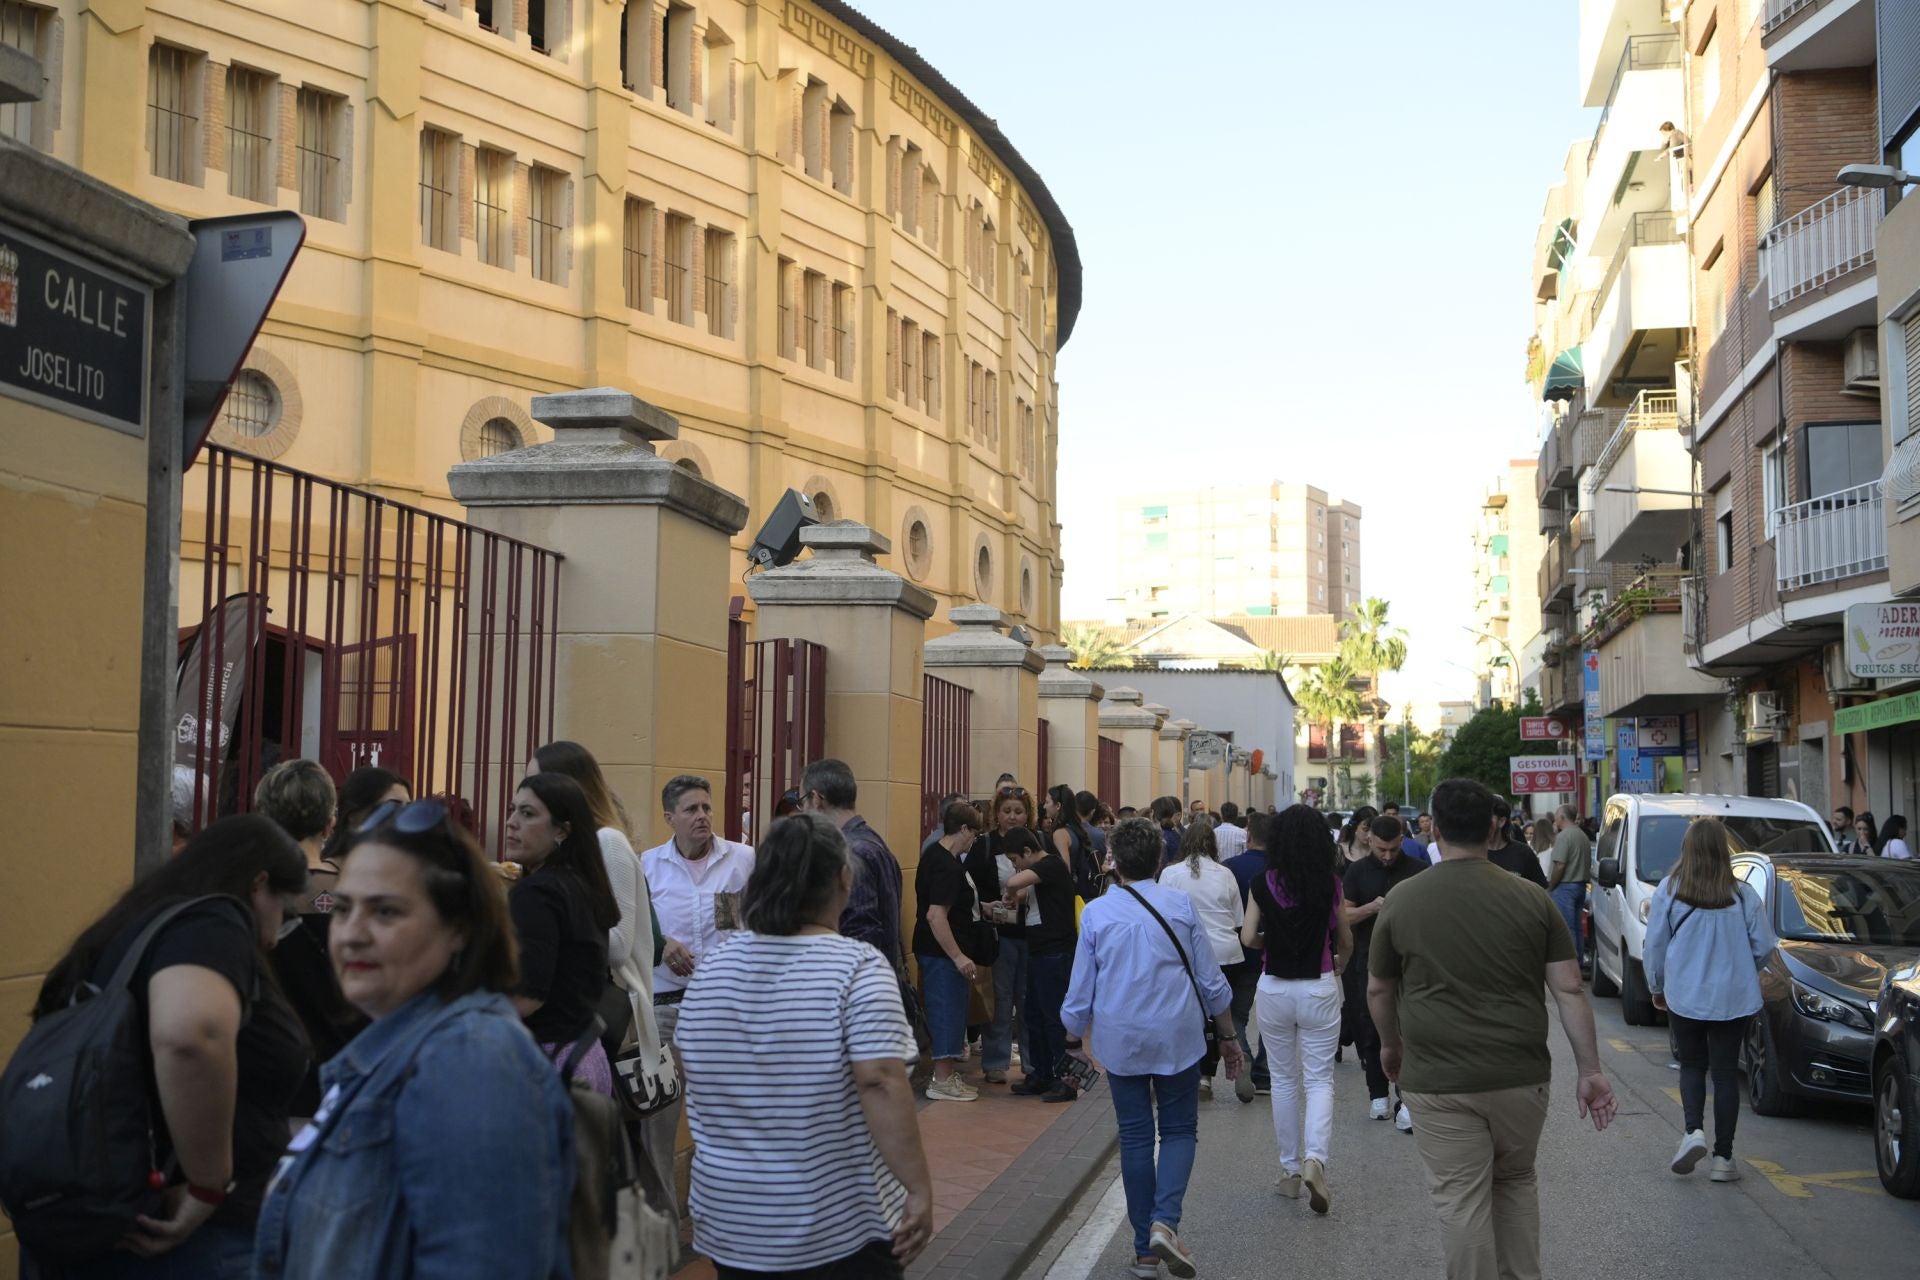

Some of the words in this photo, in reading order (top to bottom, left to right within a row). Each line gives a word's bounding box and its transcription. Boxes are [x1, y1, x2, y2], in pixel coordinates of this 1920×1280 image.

[45, 269, 128, 338] CALLE
[20, 345, 105, 400] JOSELITO
[1877, 606, 1920, 624] ADER
[1855, 663, 1895, 674] FRUTOS
[1900, 663, 1920, 674] SEC
[351, 742, 383, 753] PETA
[1517, 759, 1569, 769] GESTORÍA
[1630, 756, 1640, 773] DE
